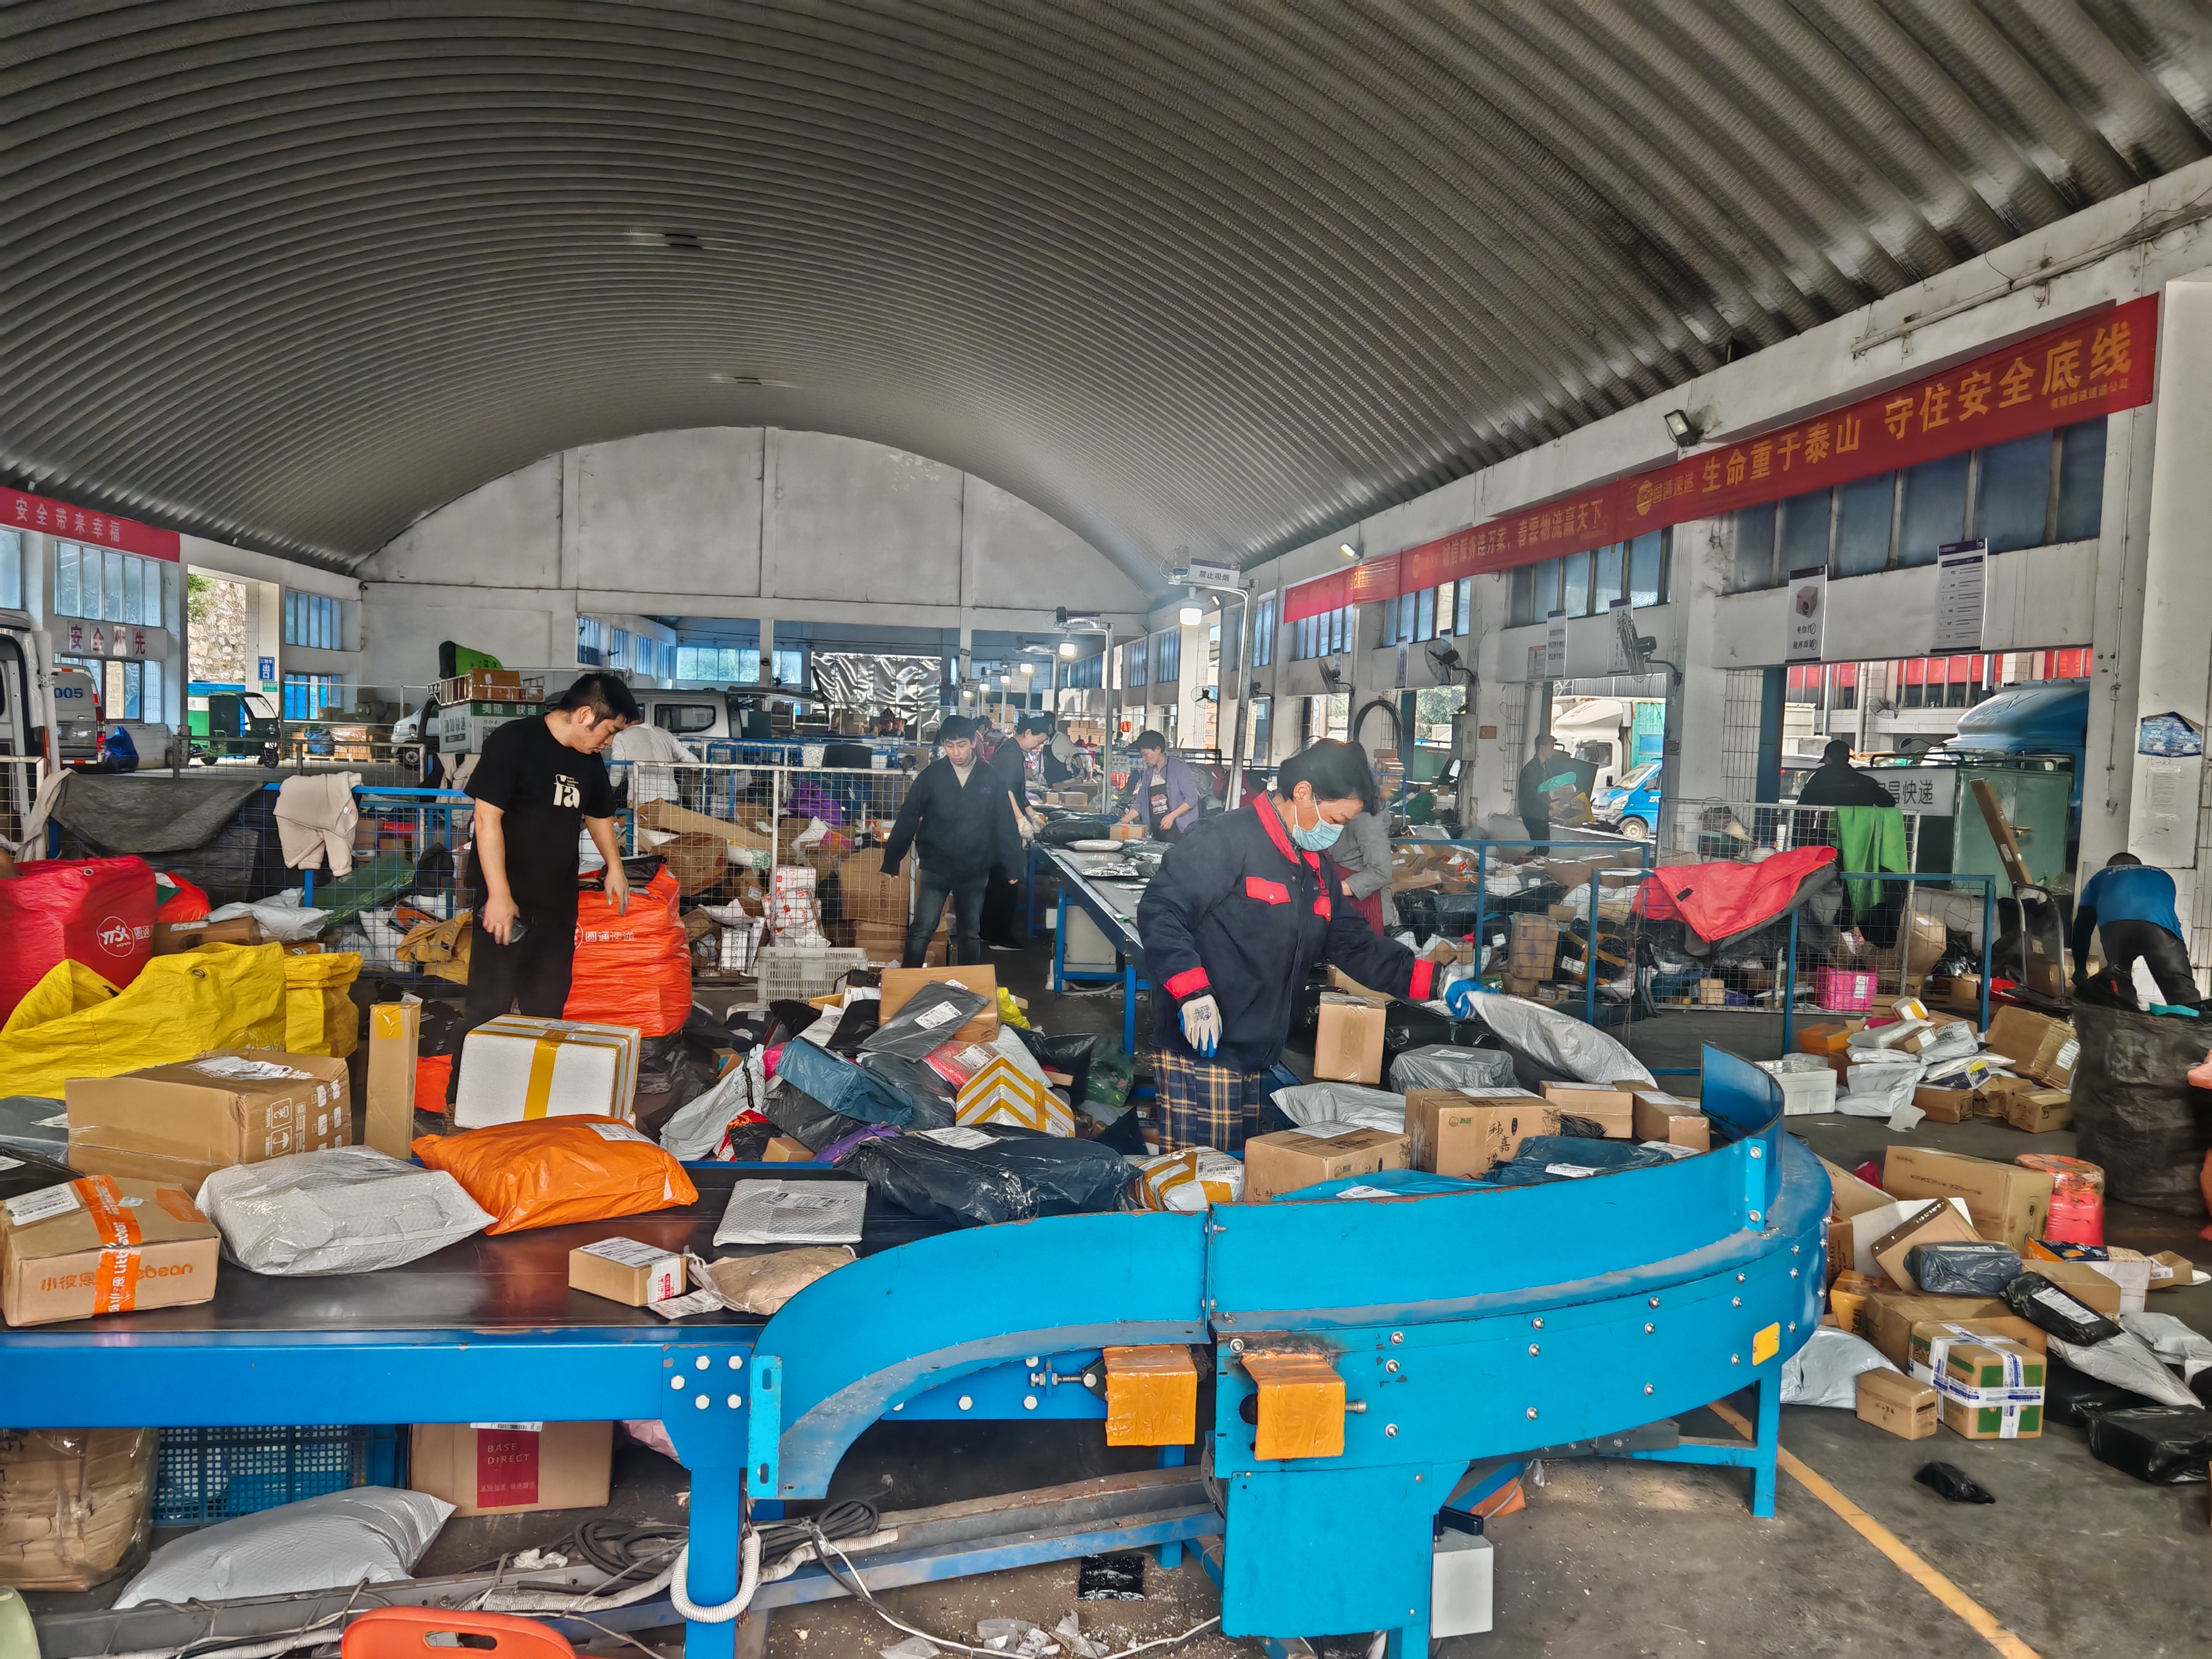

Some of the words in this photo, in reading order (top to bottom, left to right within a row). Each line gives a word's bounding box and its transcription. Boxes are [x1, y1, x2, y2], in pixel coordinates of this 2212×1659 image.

[1702, 414, 1860, 493] 生命重于泰山
[1884, 321, 2132, 440] 守住安全底线
[15, 497, 120, 542] 安全带来幸福
[1199, 570, 1230, 582] 禁止吸烟
[262, 664, 270, 678] 出口
[1878, 779, 1933, 805] 昌快递
[487, 1442, 517, 1453] BASE
[487, 1453, 530, 1465] DIRECT
